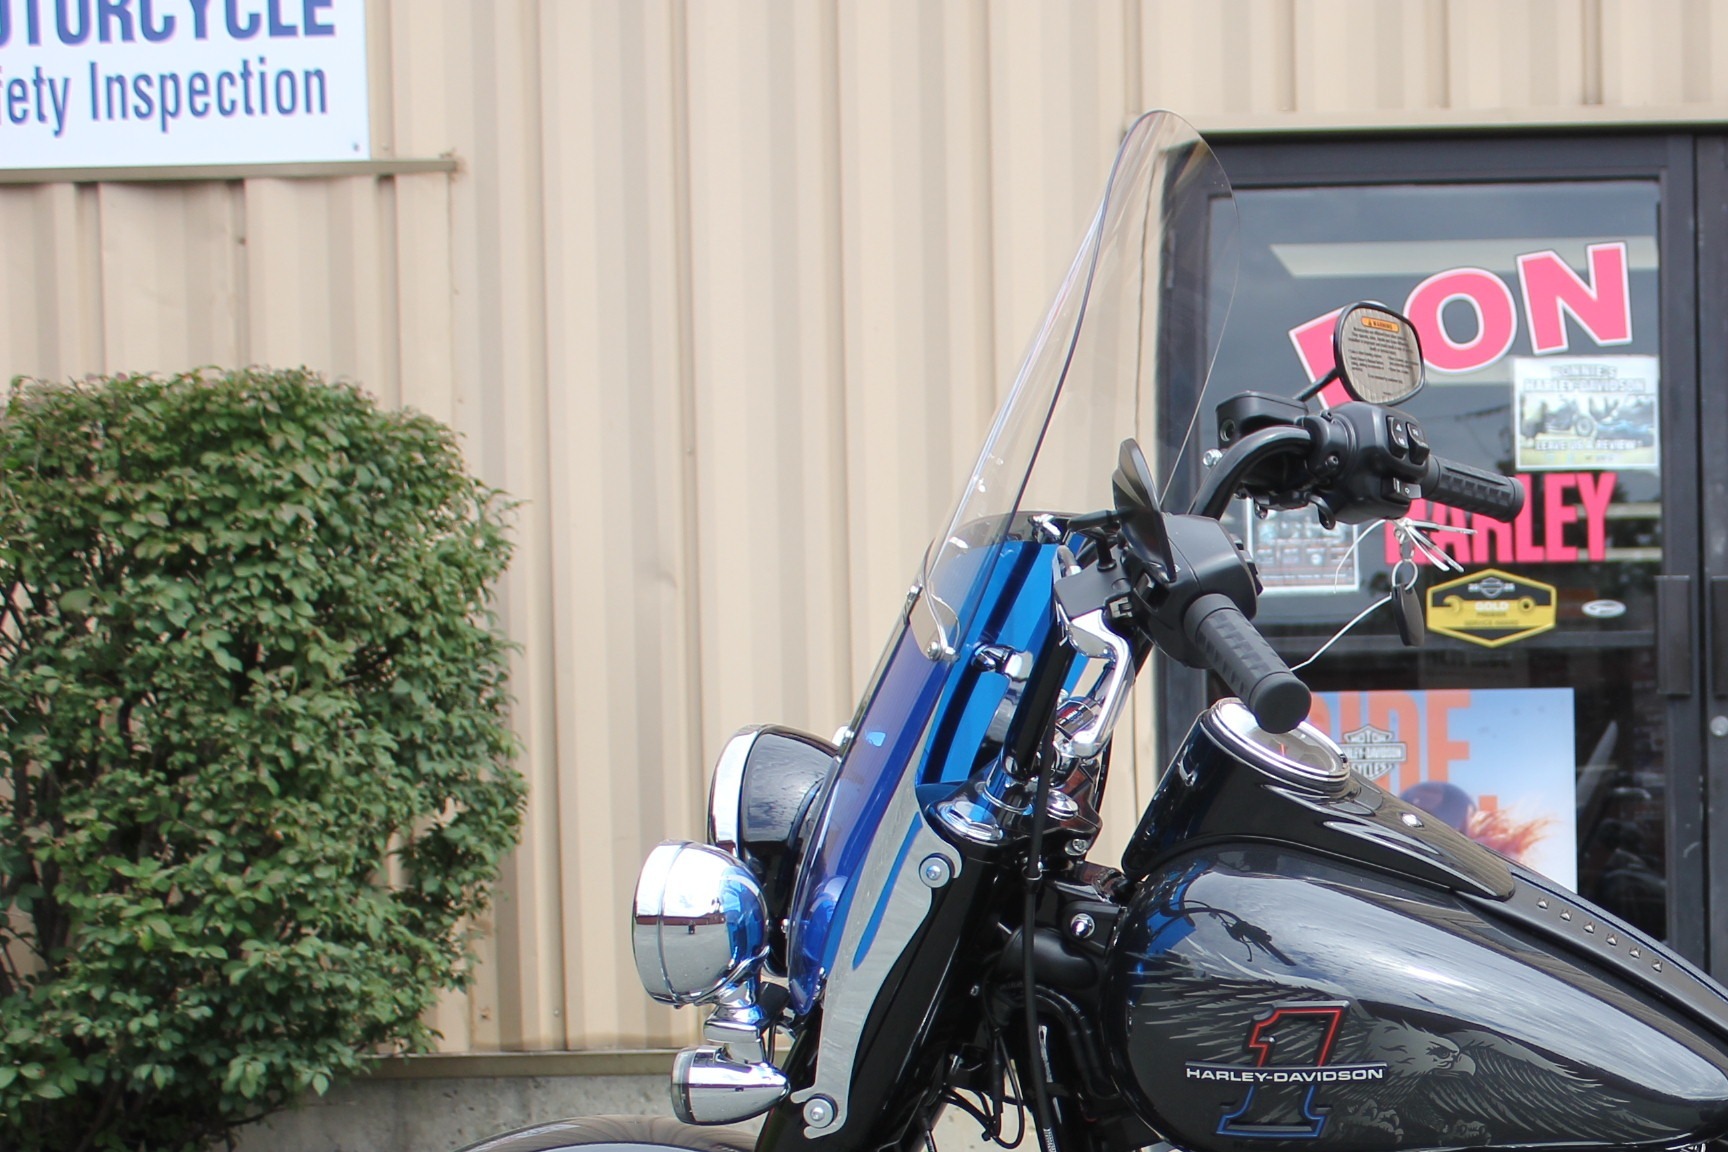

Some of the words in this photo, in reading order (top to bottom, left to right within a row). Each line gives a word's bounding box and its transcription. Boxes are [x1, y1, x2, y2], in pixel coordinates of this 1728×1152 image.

[0, 65, 71, 137] ety
[90, 55, 328, 134] Inspection
[1475, 601, 1510, 612] GOLD
[1186, 1068, 1383, 1083] HARLEY-DAVIDSON
